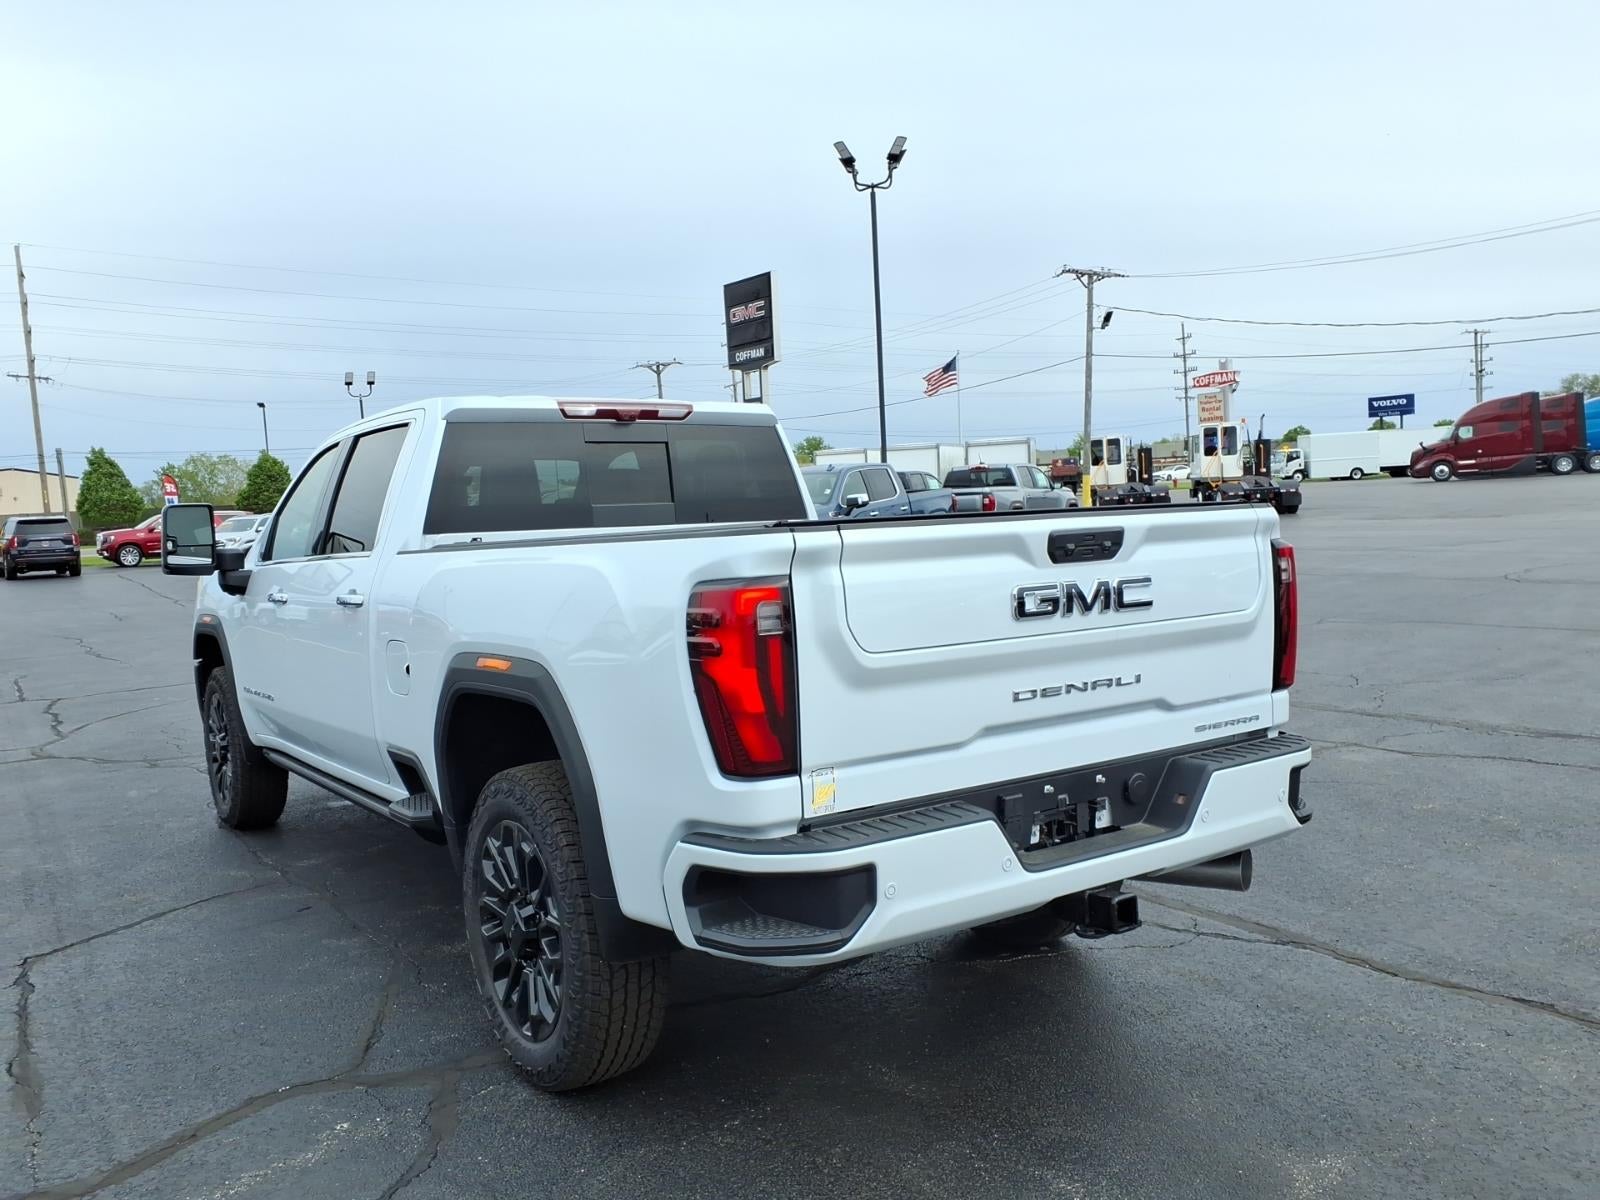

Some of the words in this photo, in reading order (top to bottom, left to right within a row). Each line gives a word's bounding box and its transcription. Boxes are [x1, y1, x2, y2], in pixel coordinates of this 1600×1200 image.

[729, 300, 765, 323] GMC
[735, 346, 765, 361] COFFMAN
[1194, 371, 1235, 387] COFFMAN
[1372, 398, 1407, 407] VOLVO
[1011, 575, 1153, 622] GMC
[1012, 673, 1142, 703] DENALI
[1194, 714, 1260, 733] SIERRA
